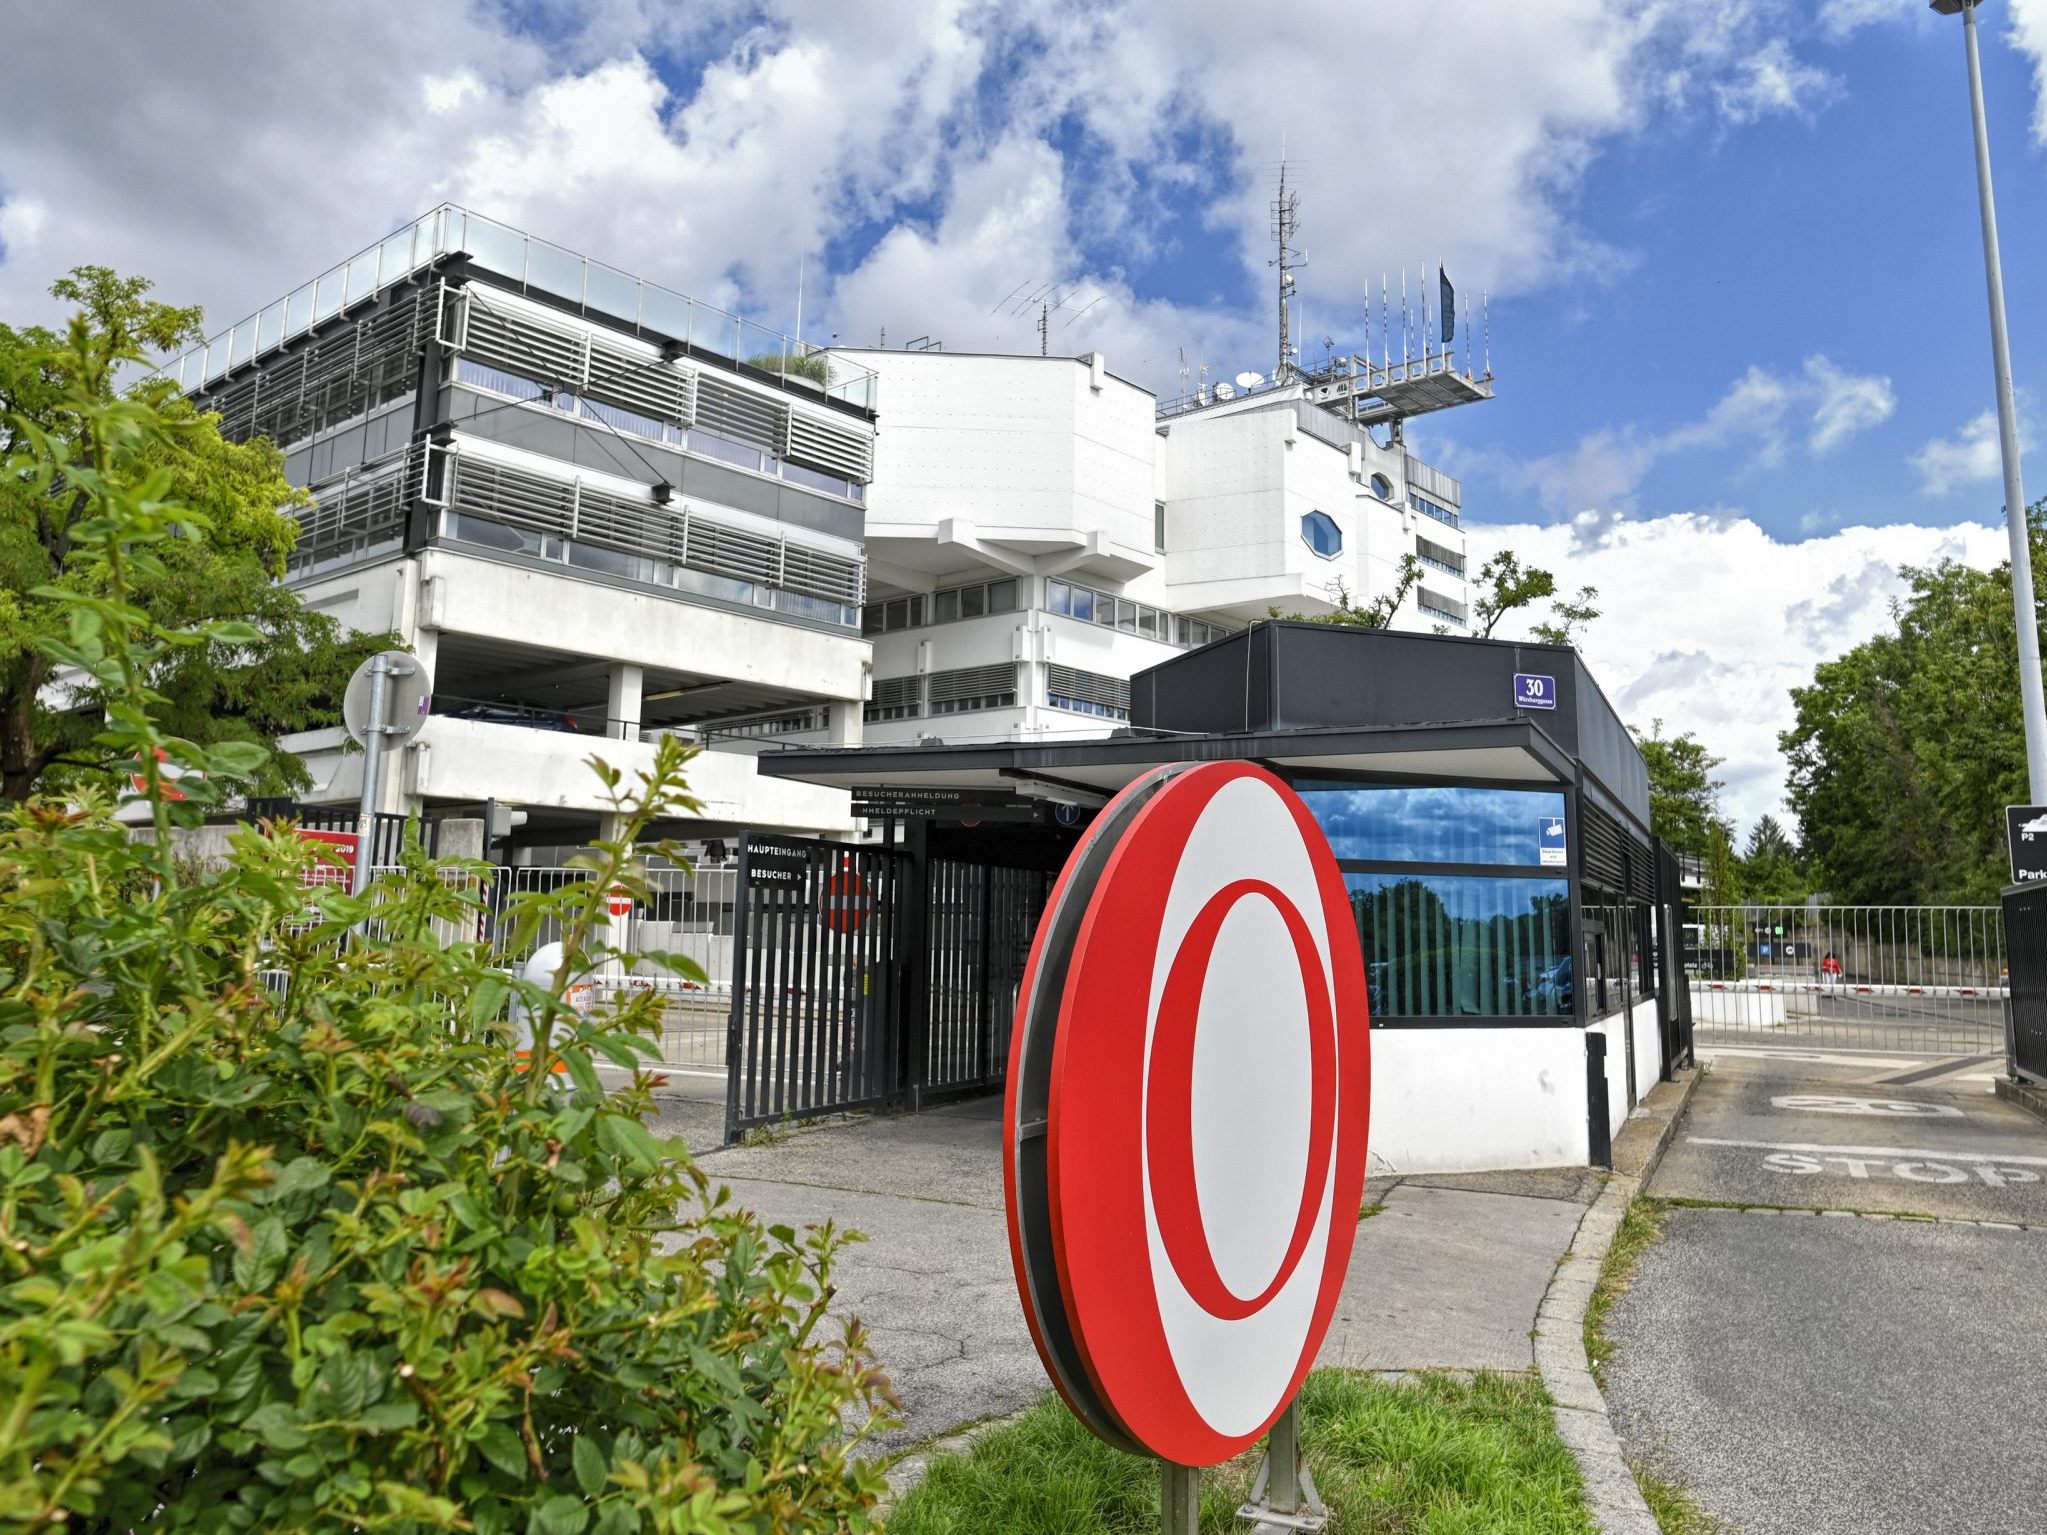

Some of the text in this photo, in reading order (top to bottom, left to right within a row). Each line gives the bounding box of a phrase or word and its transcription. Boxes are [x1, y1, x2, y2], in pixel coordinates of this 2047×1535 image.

[1526, 678, 1543, 696] 30
[856, 790, 960, 800] BESUCHERANMELDUNG
[2021, 832, 2035, 842] P2
[747, 844, 807, 859] HAUPTEINGANG
[751, 868, 792, 880] BESUCHER
[1761, 1154, 2041, 1188] STOP
